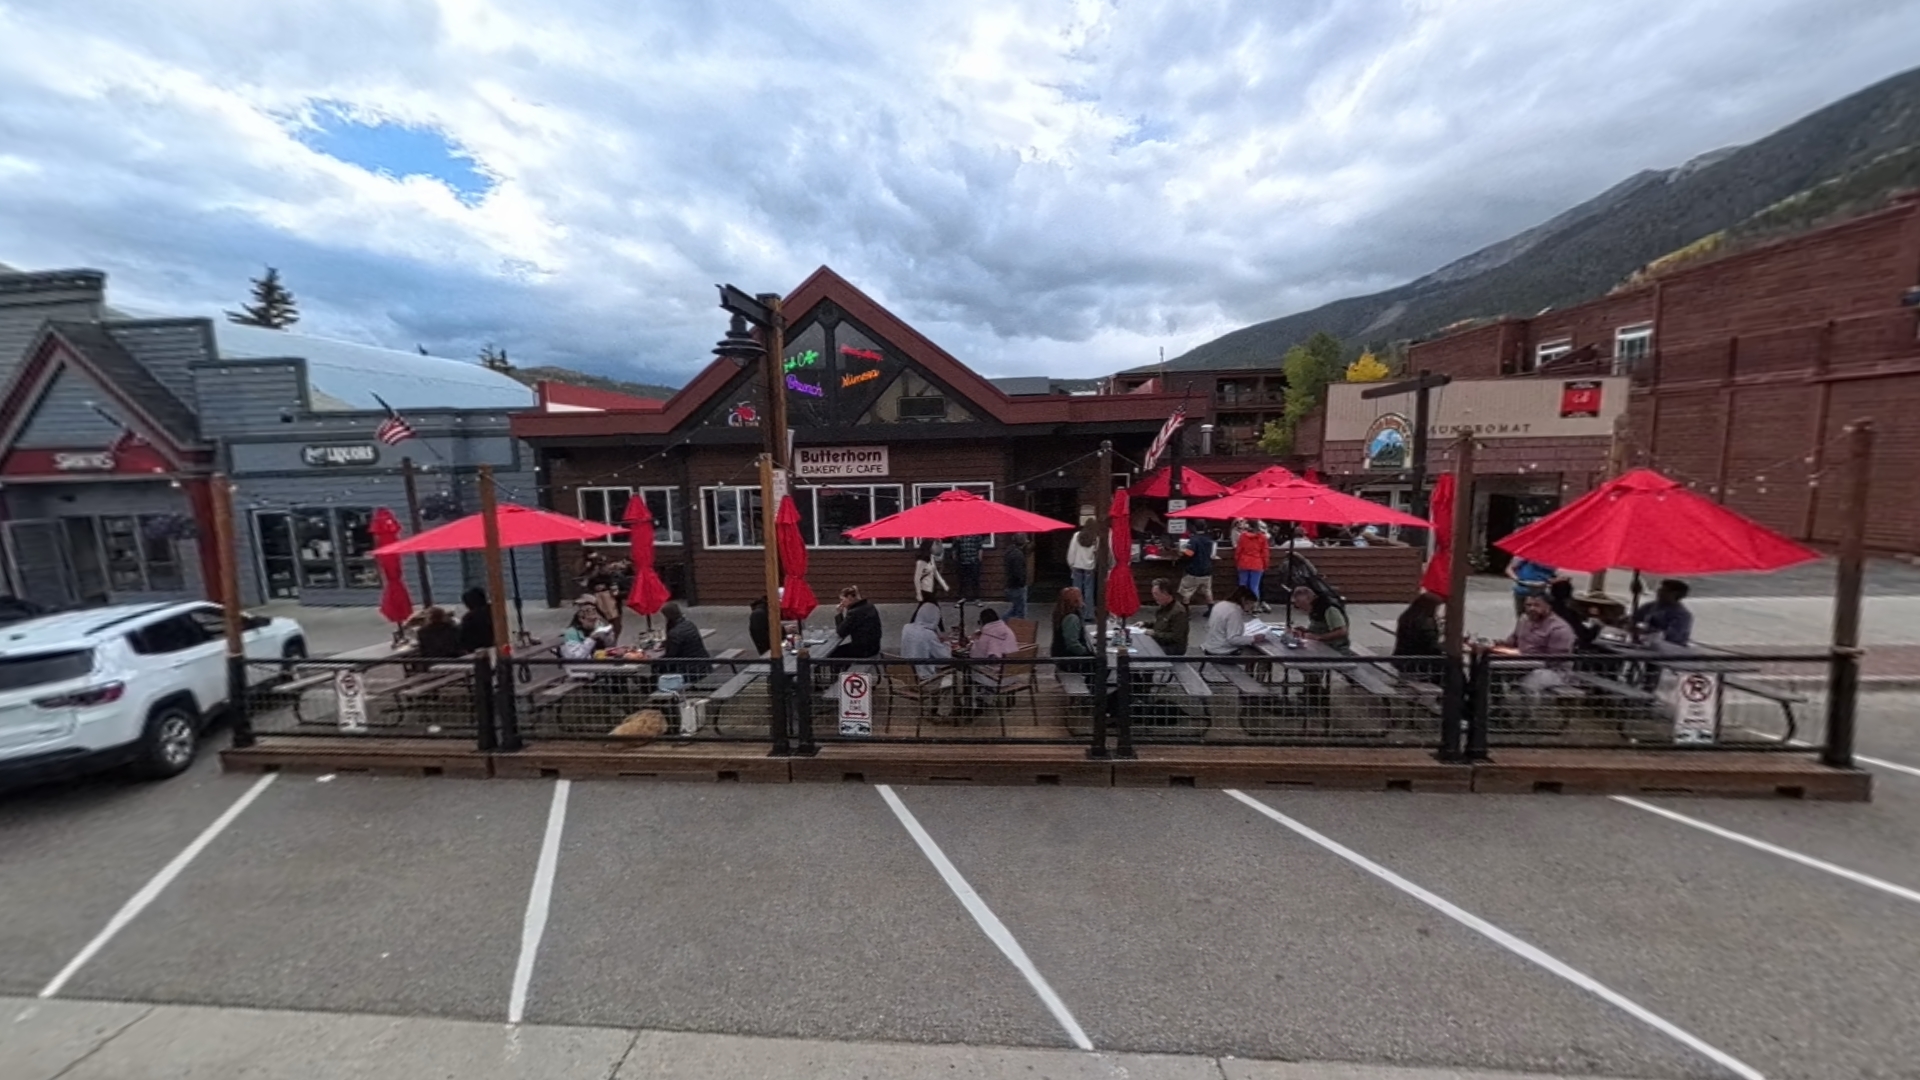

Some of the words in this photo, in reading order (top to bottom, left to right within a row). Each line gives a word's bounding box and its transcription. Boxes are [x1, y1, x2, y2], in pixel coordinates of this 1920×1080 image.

[801, 449, 882, 463] Butterhorn
[802, 465, 842, 474] BAKERY
[846, 465, 854, 473] &
[857, 464, 884, 474] CAFE
